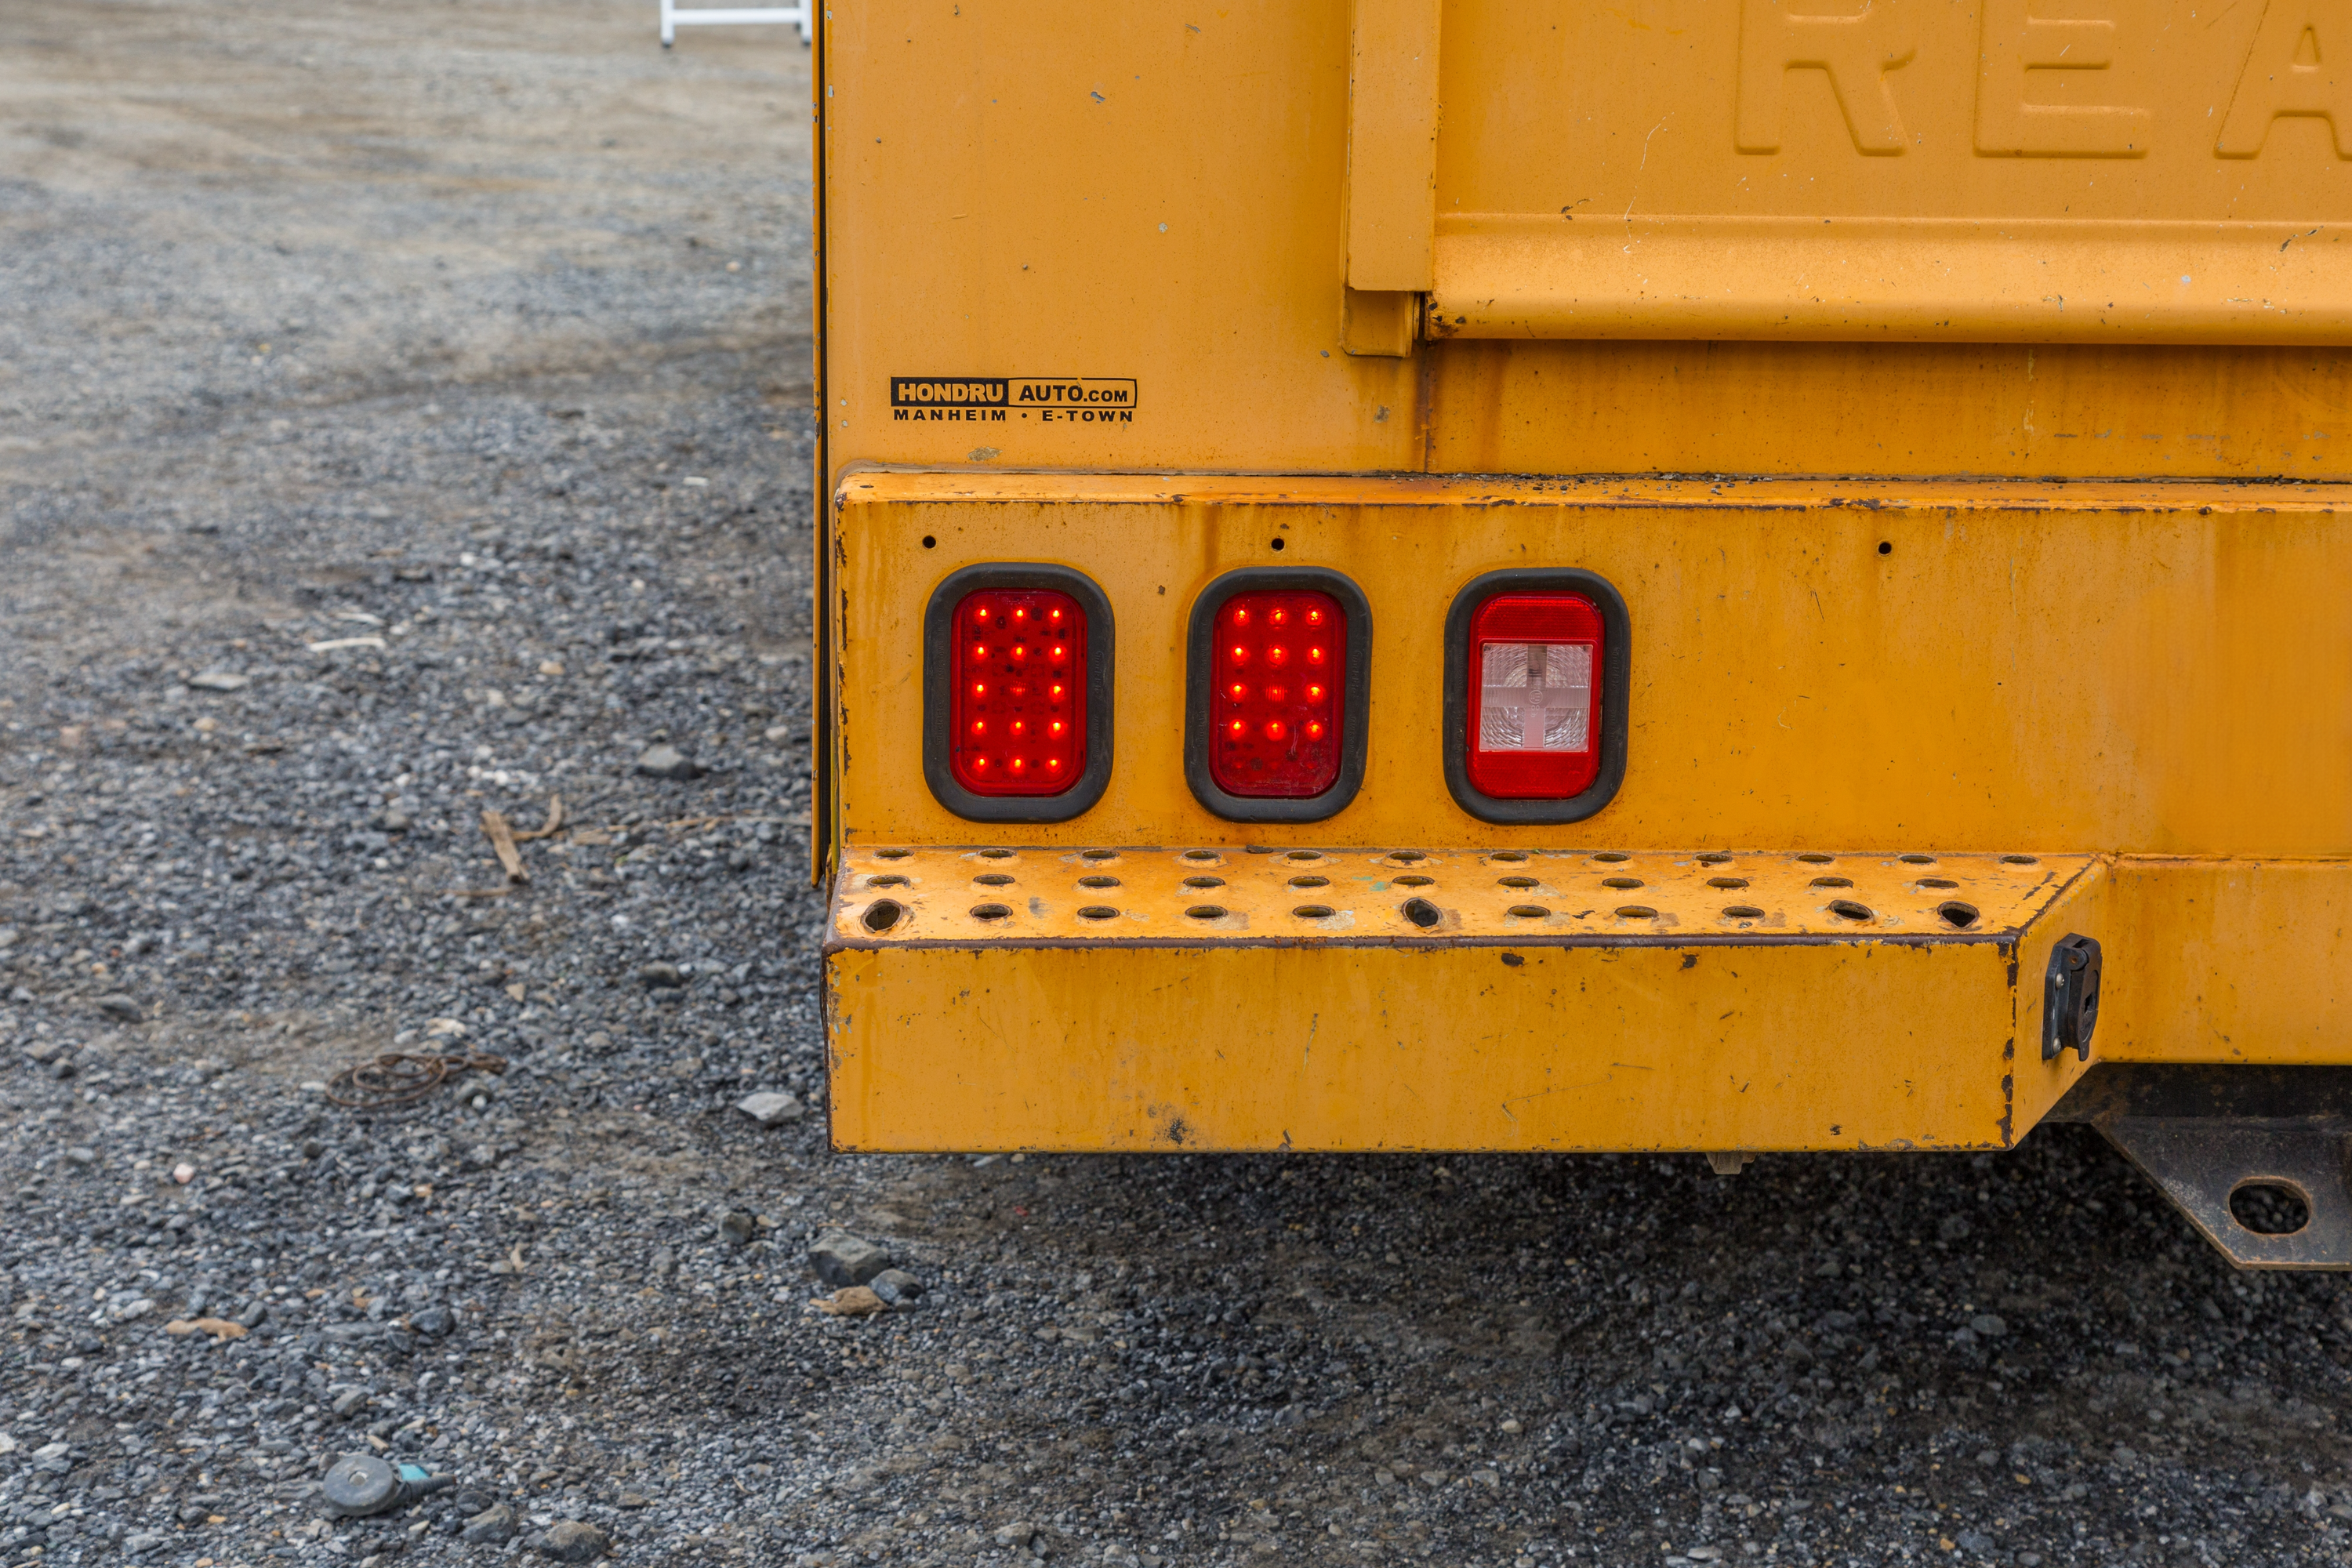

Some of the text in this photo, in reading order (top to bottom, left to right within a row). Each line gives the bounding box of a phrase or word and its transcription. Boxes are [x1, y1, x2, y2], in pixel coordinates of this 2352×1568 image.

[898, 383, 1004, 402] HONDRU
[894, 409, 1133, 422] MANHEIM E-TOWN
